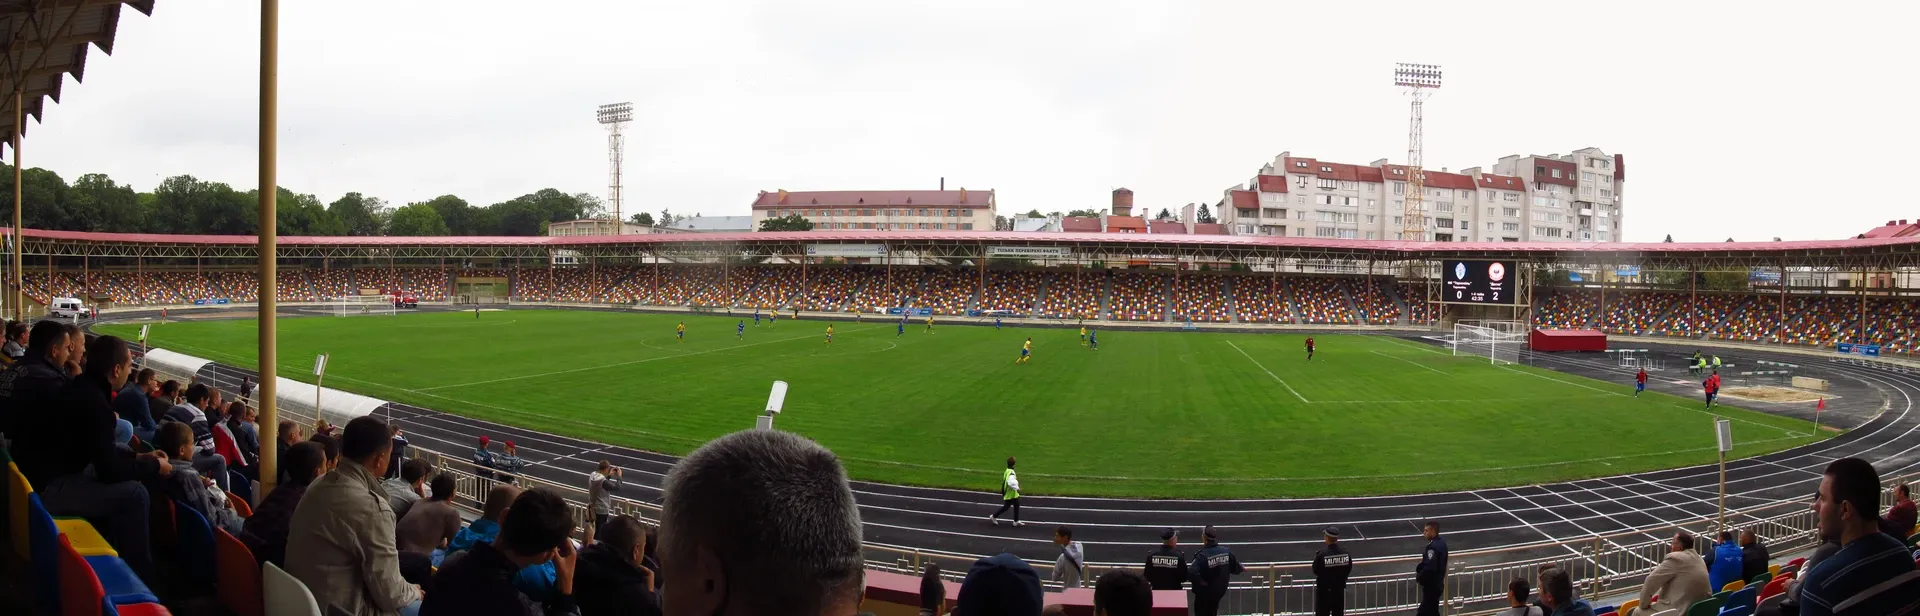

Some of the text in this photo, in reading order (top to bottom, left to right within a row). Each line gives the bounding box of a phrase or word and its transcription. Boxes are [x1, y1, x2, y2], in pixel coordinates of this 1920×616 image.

[1456, 290, 1462, 299] 0
[1492, 292, 1498, 300] 2
[1152, 557, 1178, 566] МІЛІЦІЯ
[1208, 555, 1230, 566] МІЛІЦІЯ
[1324, 556, 1349, 565] МІЛІЦІЯ
